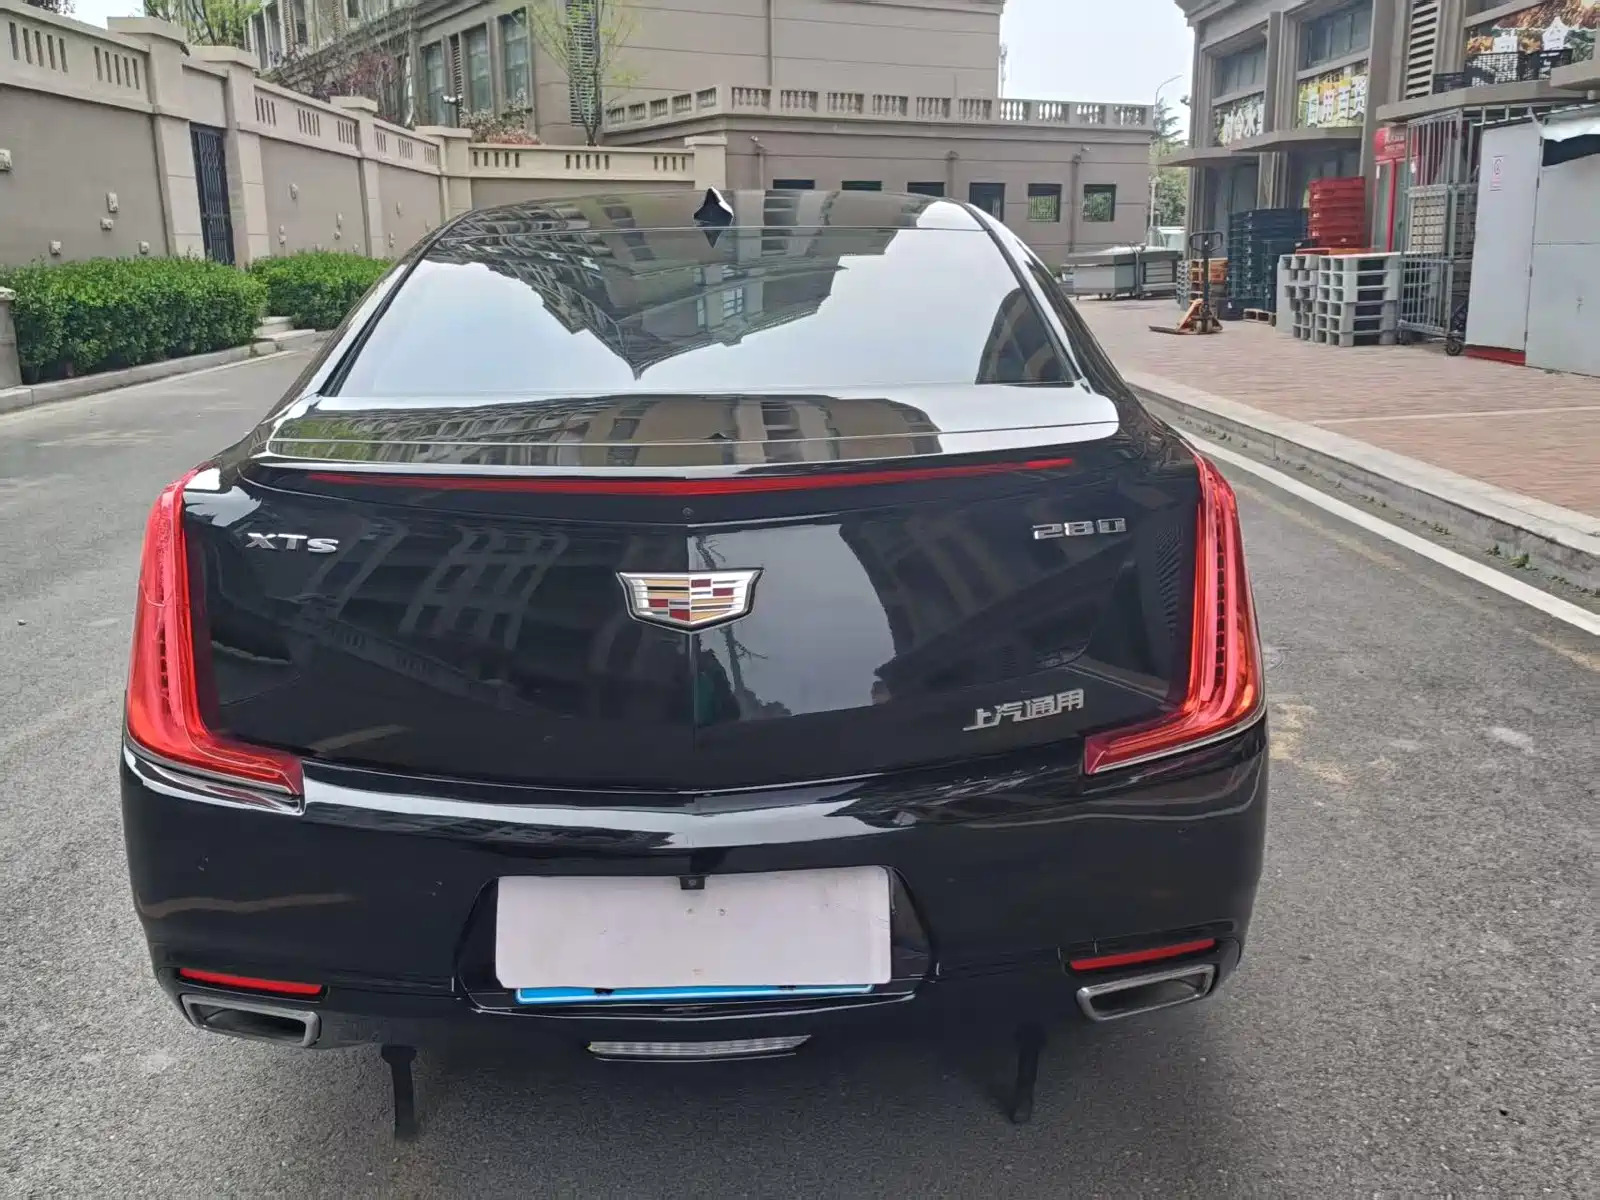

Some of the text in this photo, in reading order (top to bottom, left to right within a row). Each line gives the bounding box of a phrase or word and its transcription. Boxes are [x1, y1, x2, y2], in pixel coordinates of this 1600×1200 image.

[1031, 517, 1127, 540] 280
[245, 532, 339, 553] XTS
[962, 688, 1084, 732] 上汽通用
